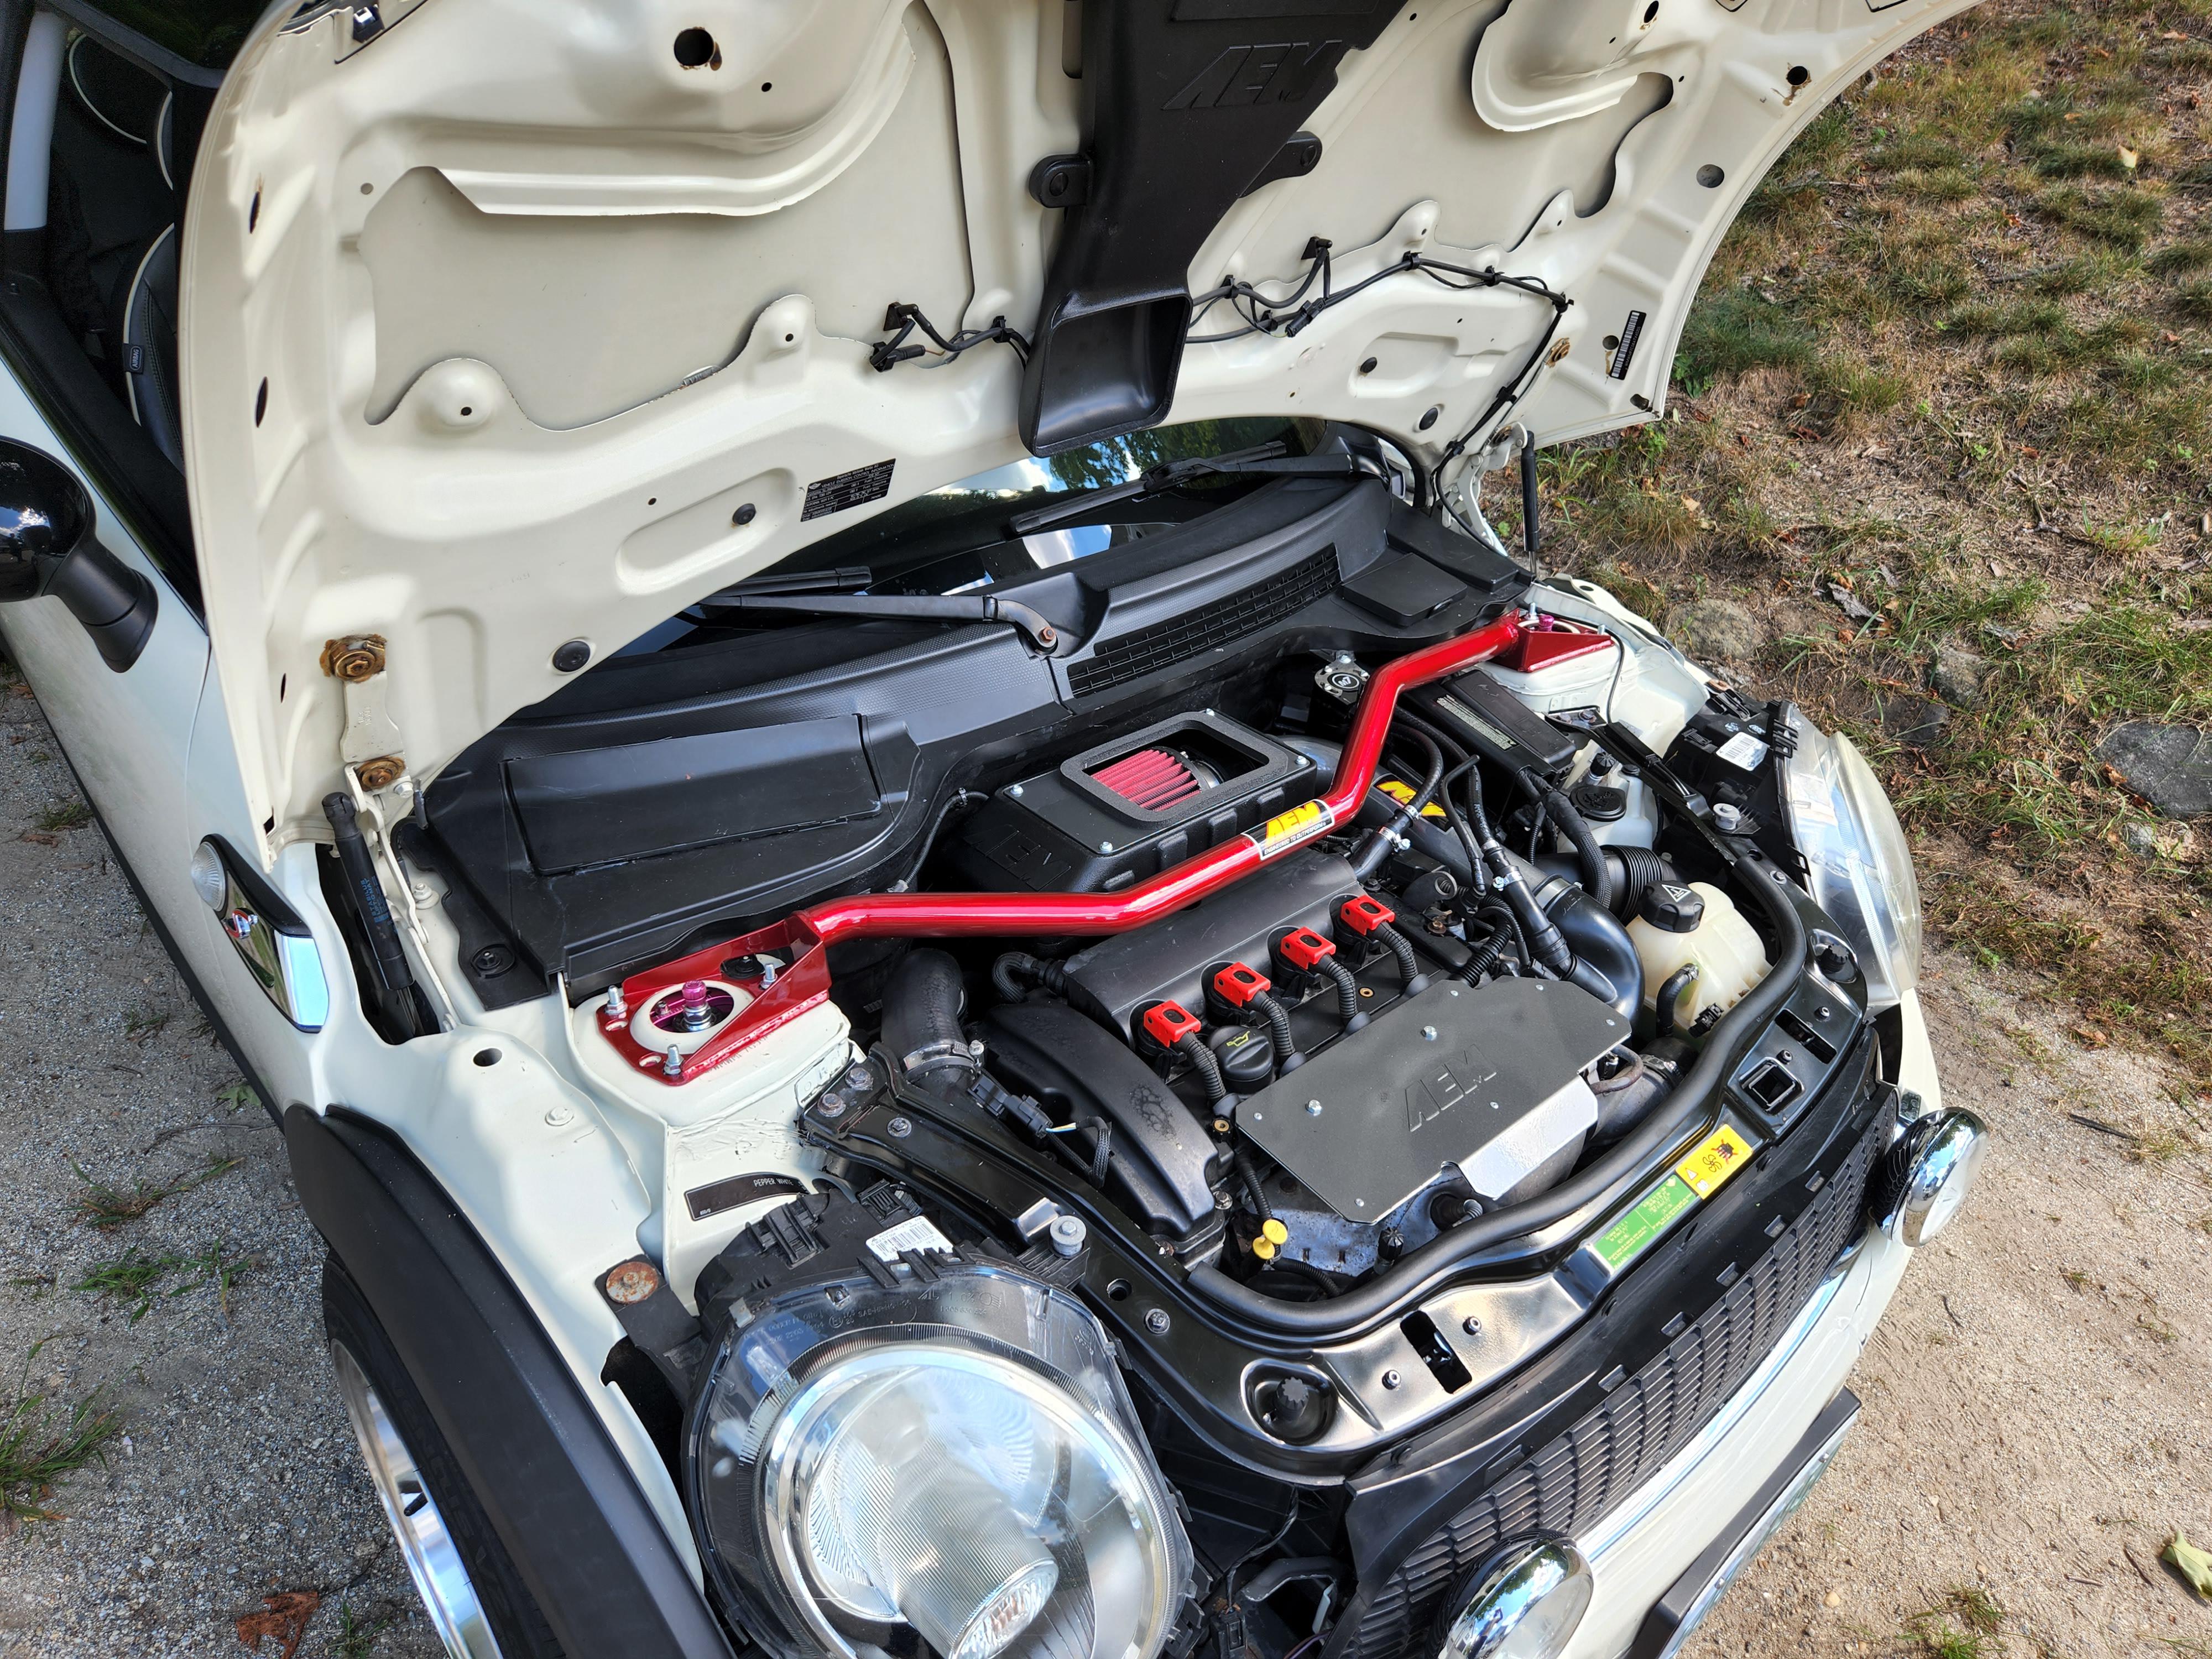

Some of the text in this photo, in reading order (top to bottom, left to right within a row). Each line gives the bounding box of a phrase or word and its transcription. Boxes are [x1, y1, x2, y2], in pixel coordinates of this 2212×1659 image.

[1161, 40, 1343, 111] AEM
[1338, 676, 1351, 686] M7
[1265, 801, 1322, 847] AEM
[1264, 838, 1290, 855] ENGINEERED
[1405, 1043, 1497, 1132] AEM
[753, 1177, 794, 1187] PEPPER WHITE
